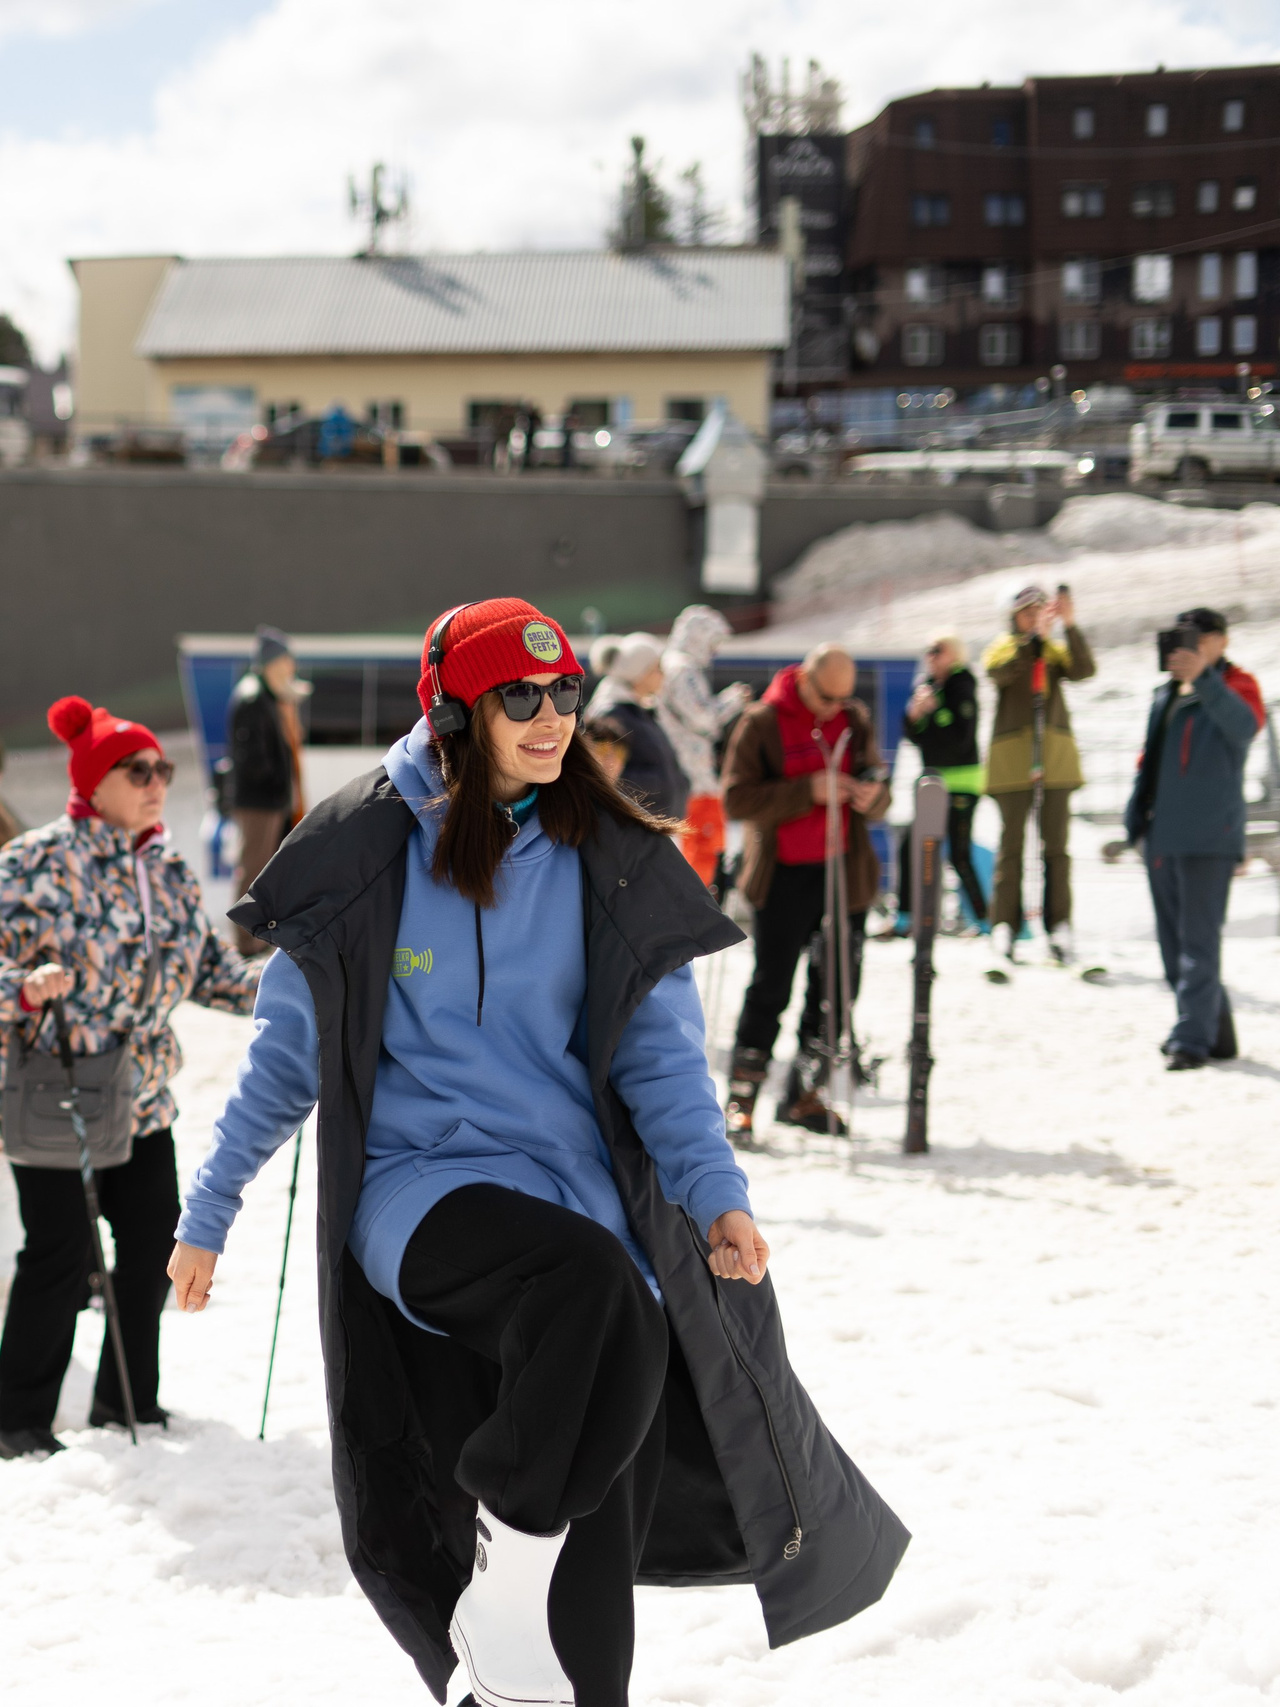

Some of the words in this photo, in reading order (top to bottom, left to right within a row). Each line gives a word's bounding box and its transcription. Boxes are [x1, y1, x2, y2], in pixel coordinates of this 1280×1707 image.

[526, 631, 555, 642] GRELKA
[532, 641, 551, 653] FEST
[434, 696, 441, 706] 2
